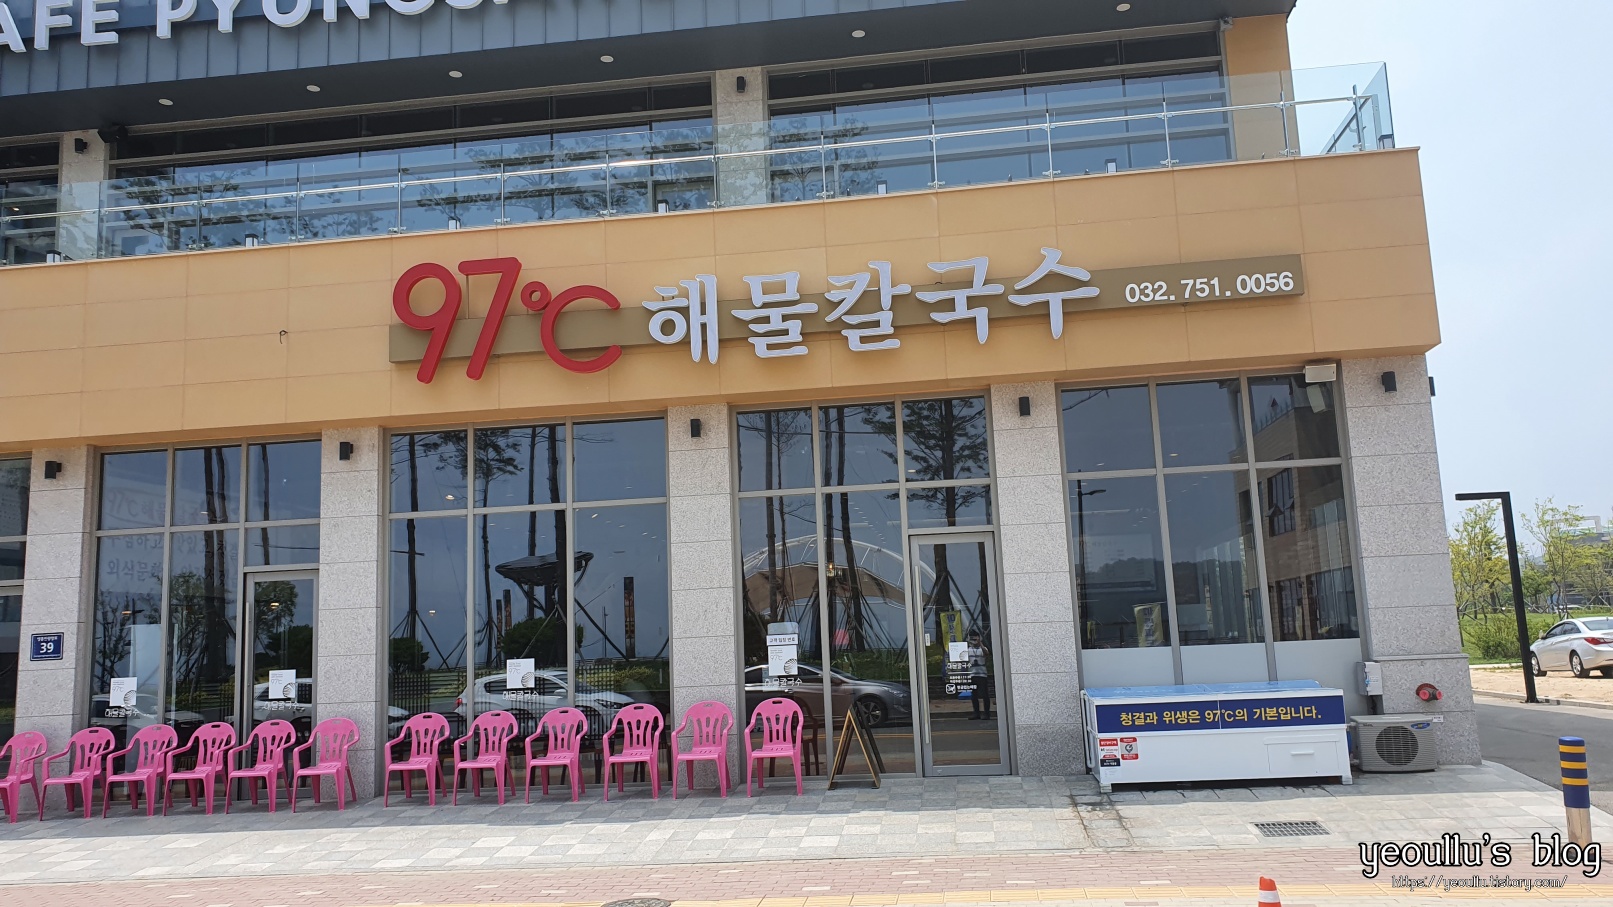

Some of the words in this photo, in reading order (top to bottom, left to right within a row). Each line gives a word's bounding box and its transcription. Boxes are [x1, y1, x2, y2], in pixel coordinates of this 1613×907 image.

[641, 246, 1100, 364] 해물칼국수
[39, 642, 54, 653] 39
[1119, 711, 1158, 726] 청결과
[1162, 709, 1201, 724] 위생은
[1253, 705, 1322, 721] 기본입니다.
